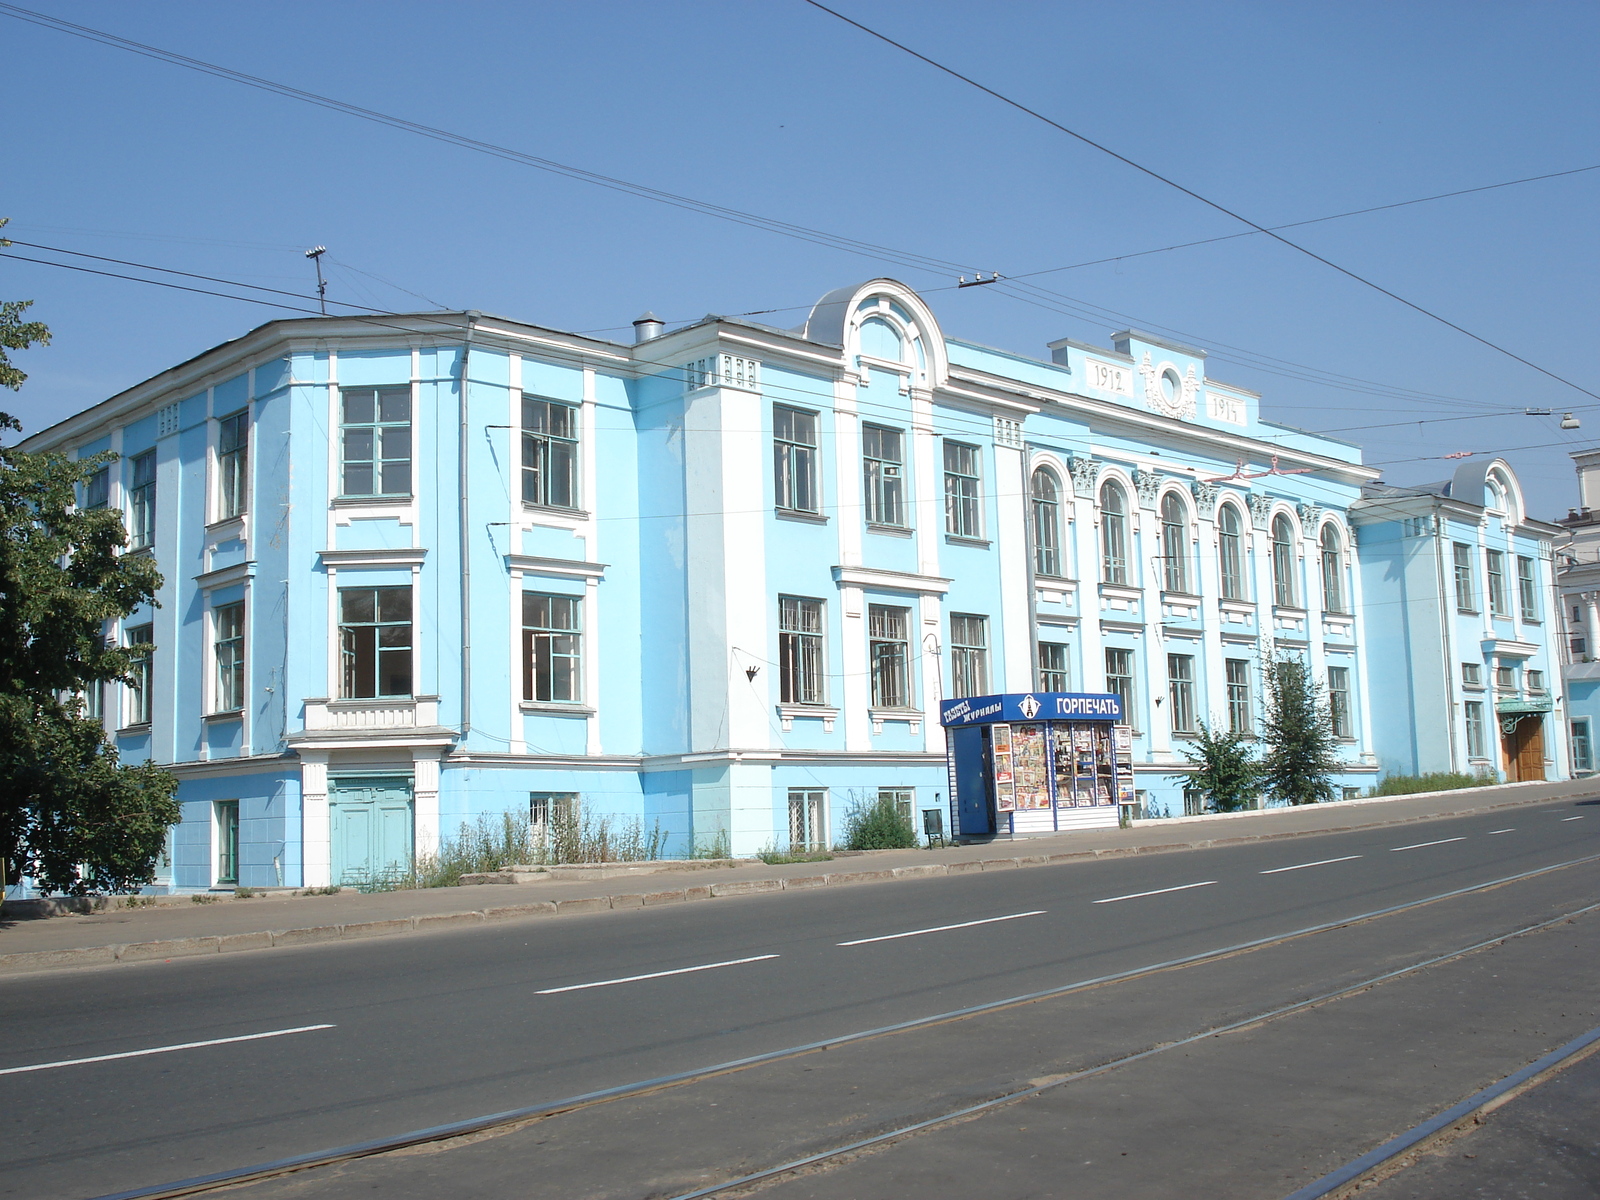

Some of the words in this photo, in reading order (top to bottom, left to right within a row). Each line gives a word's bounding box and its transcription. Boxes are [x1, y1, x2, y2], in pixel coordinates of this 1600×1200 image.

[943, 700, 971, 723] ГАЗЕТЫ
[963, 703, 1002, 723] ЖУРНАЛЫ
[1056, 698, 1119, 714] ГОРПЕЧАТЬ
